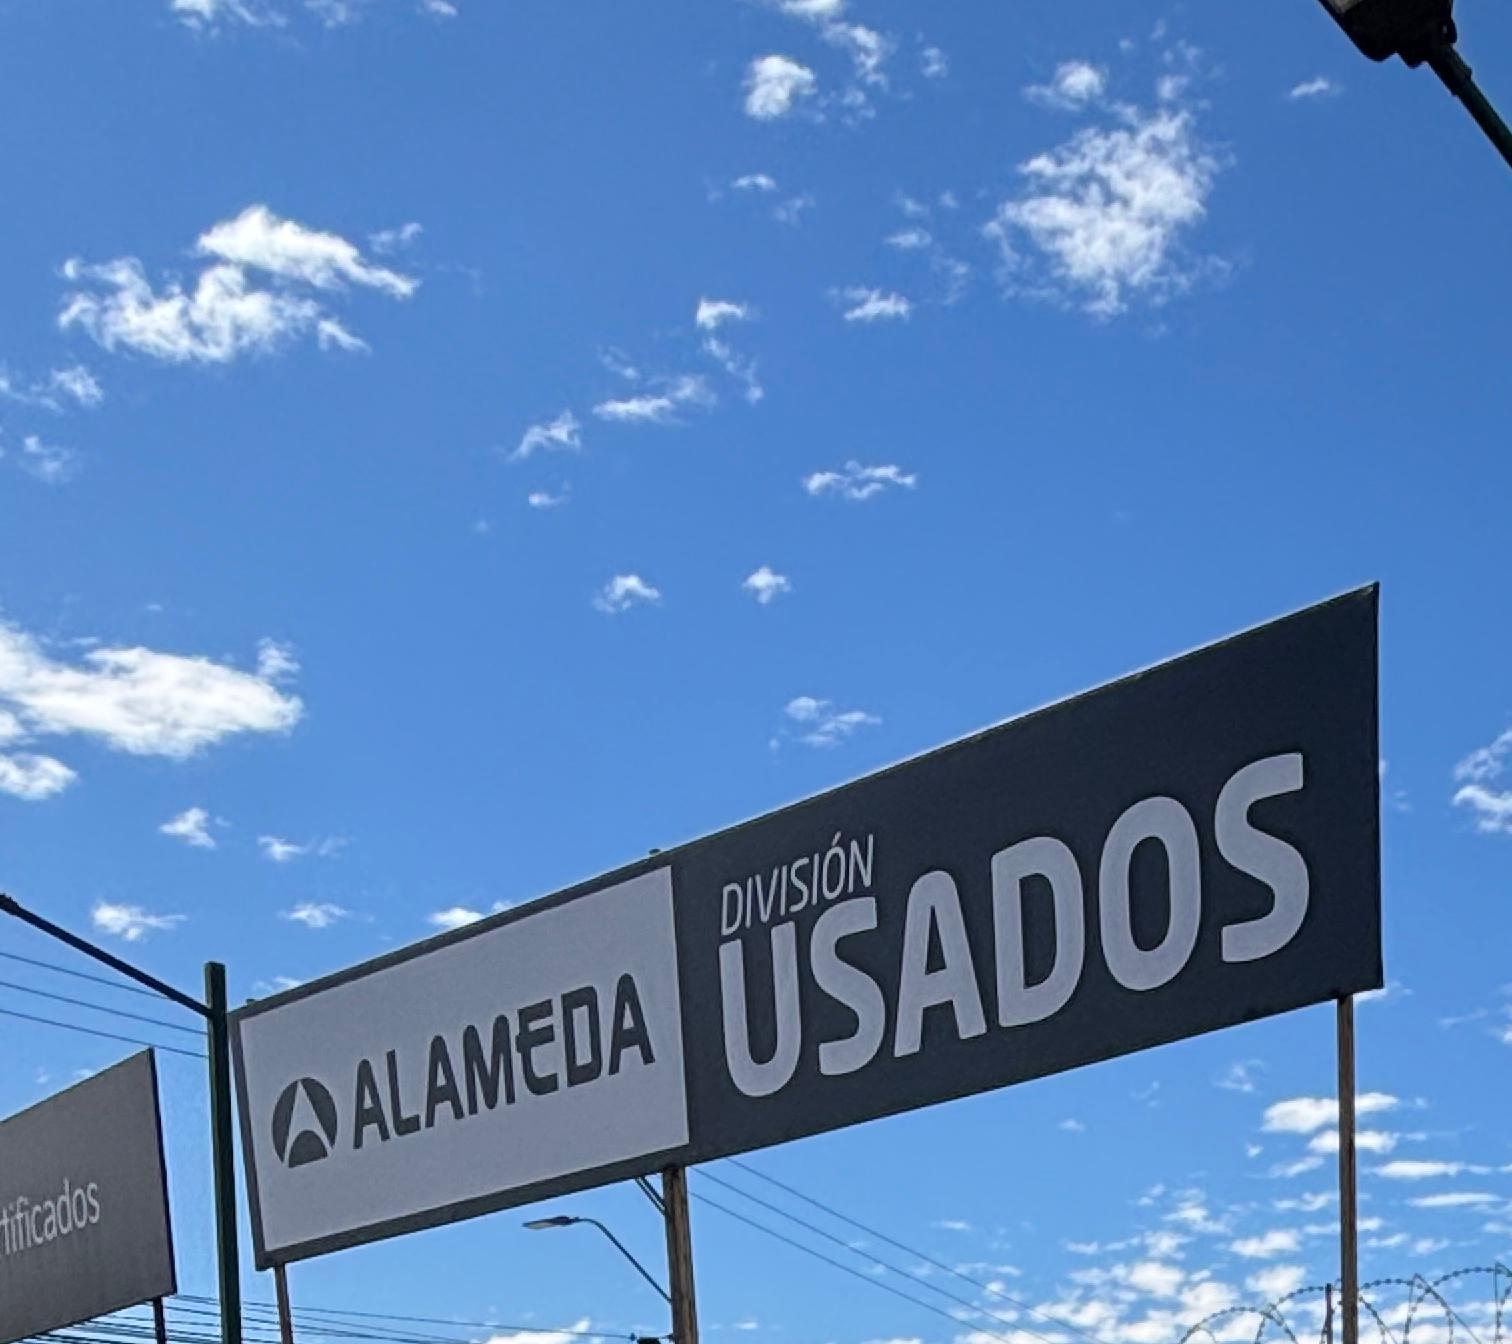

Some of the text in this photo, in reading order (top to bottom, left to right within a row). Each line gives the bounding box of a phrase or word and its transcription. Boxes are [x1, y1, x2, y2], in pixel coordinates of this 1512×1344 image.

[718, 752, 1310, 1098] USADOS
[720, 830, 875, 937] DIVISIÓN
[352, 972, 657, 1150] ALAMEDA
